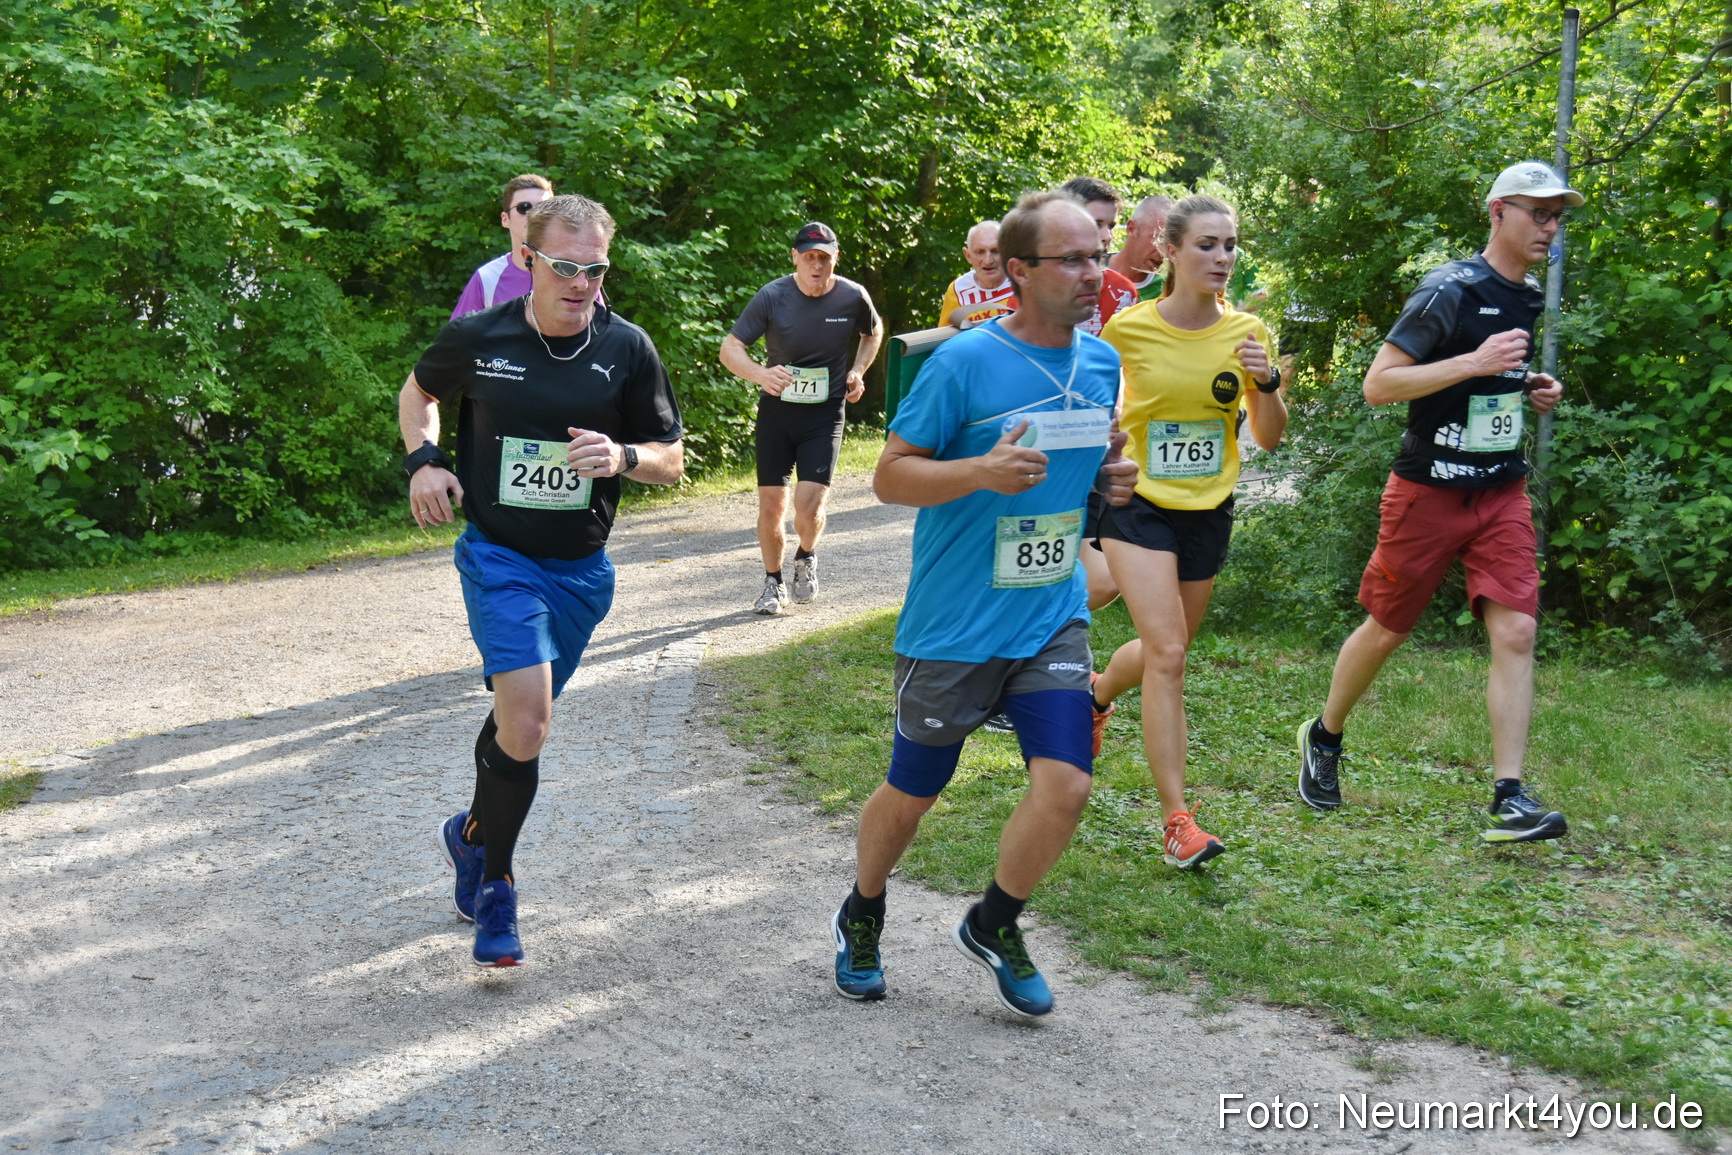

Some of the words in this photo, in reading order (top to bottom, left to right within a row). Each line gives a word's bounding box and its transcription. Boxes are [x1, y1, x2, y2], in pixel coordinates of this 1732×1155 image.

[1478, 307, 1500, 315] JAKO
[474, 358, 486, 368] Be
[792, 380, 817, 393] 171
[1491, 414, 1512, 436] 99
[1158, 440, 1214, 463] 1763
[511, 463, 580, 491] 2403
[521, 488, 537, 497] Zich
[538, 490, 570, 498] Christian
[1016, 538, 1065, 568] 838
[1018, 568, 1040, 576] Pirzer
[1048, 662, 1086, 672] DONIC
